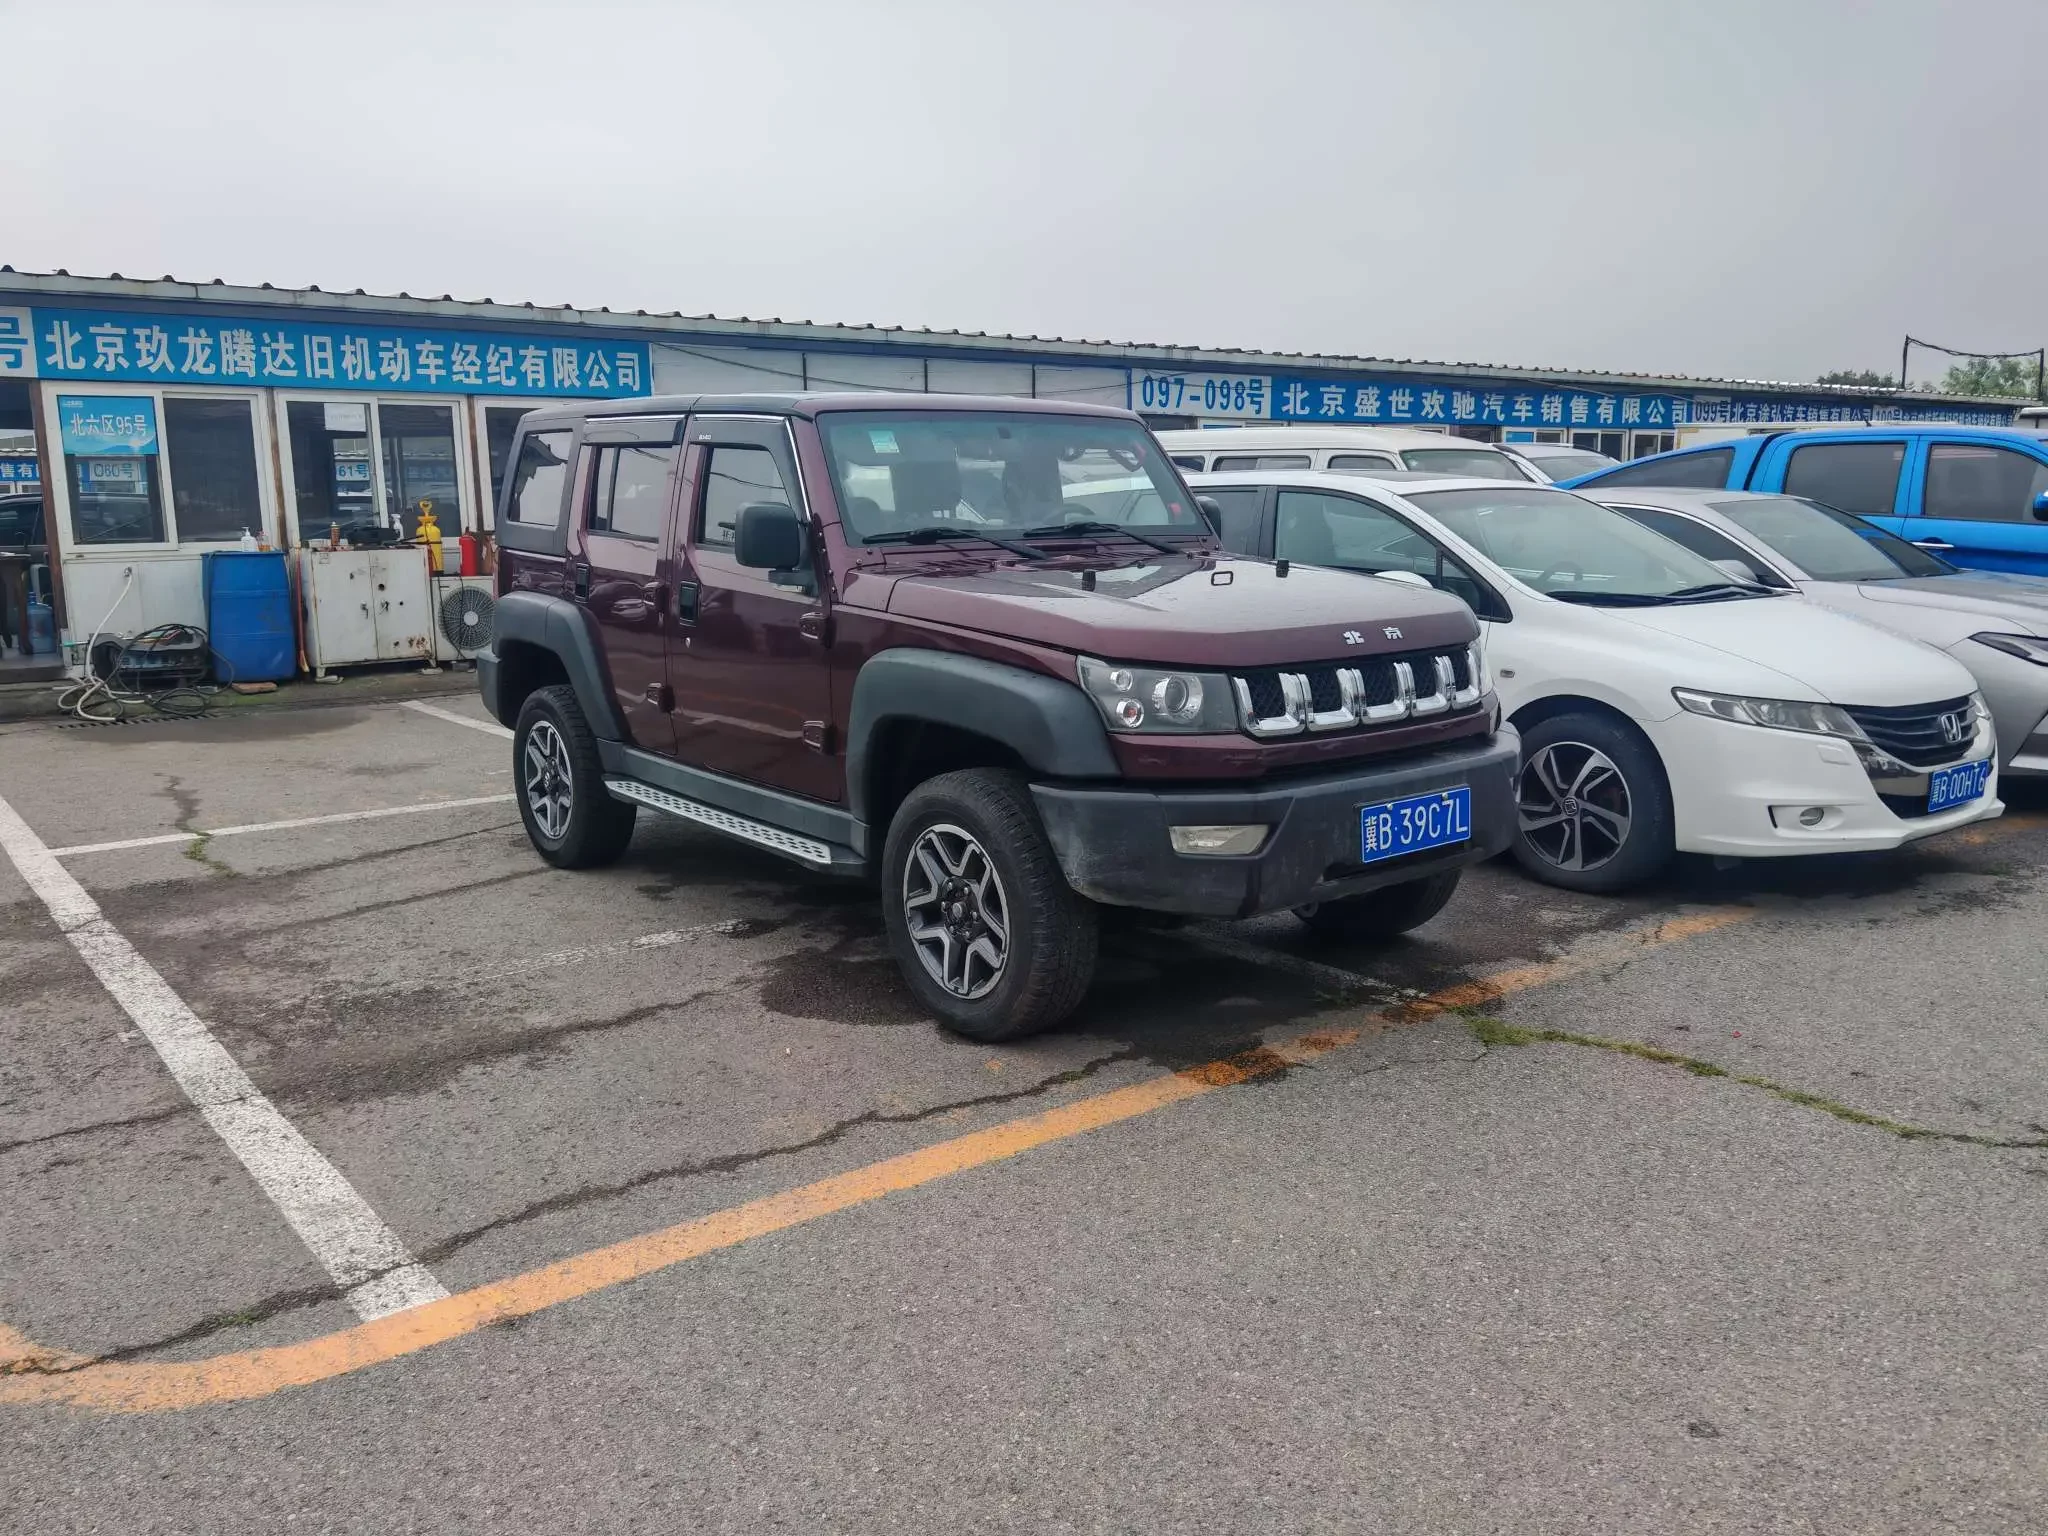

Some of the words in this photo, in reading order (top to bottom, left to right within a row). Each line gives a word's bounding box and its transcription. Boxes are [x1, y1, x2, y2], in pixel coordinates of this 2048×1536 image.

[45, 320, 640, 392] 北京玖龙腾达旧机动车经纪有限公司
[1142, 375, 1265, 415] 097-098号
[1282, 382, 1689, 425] 北京盛世欢驰汽车销售有限公司
[70, 413, 148, 437] 北六区95号
[0, 462, 40, 478] 售有
